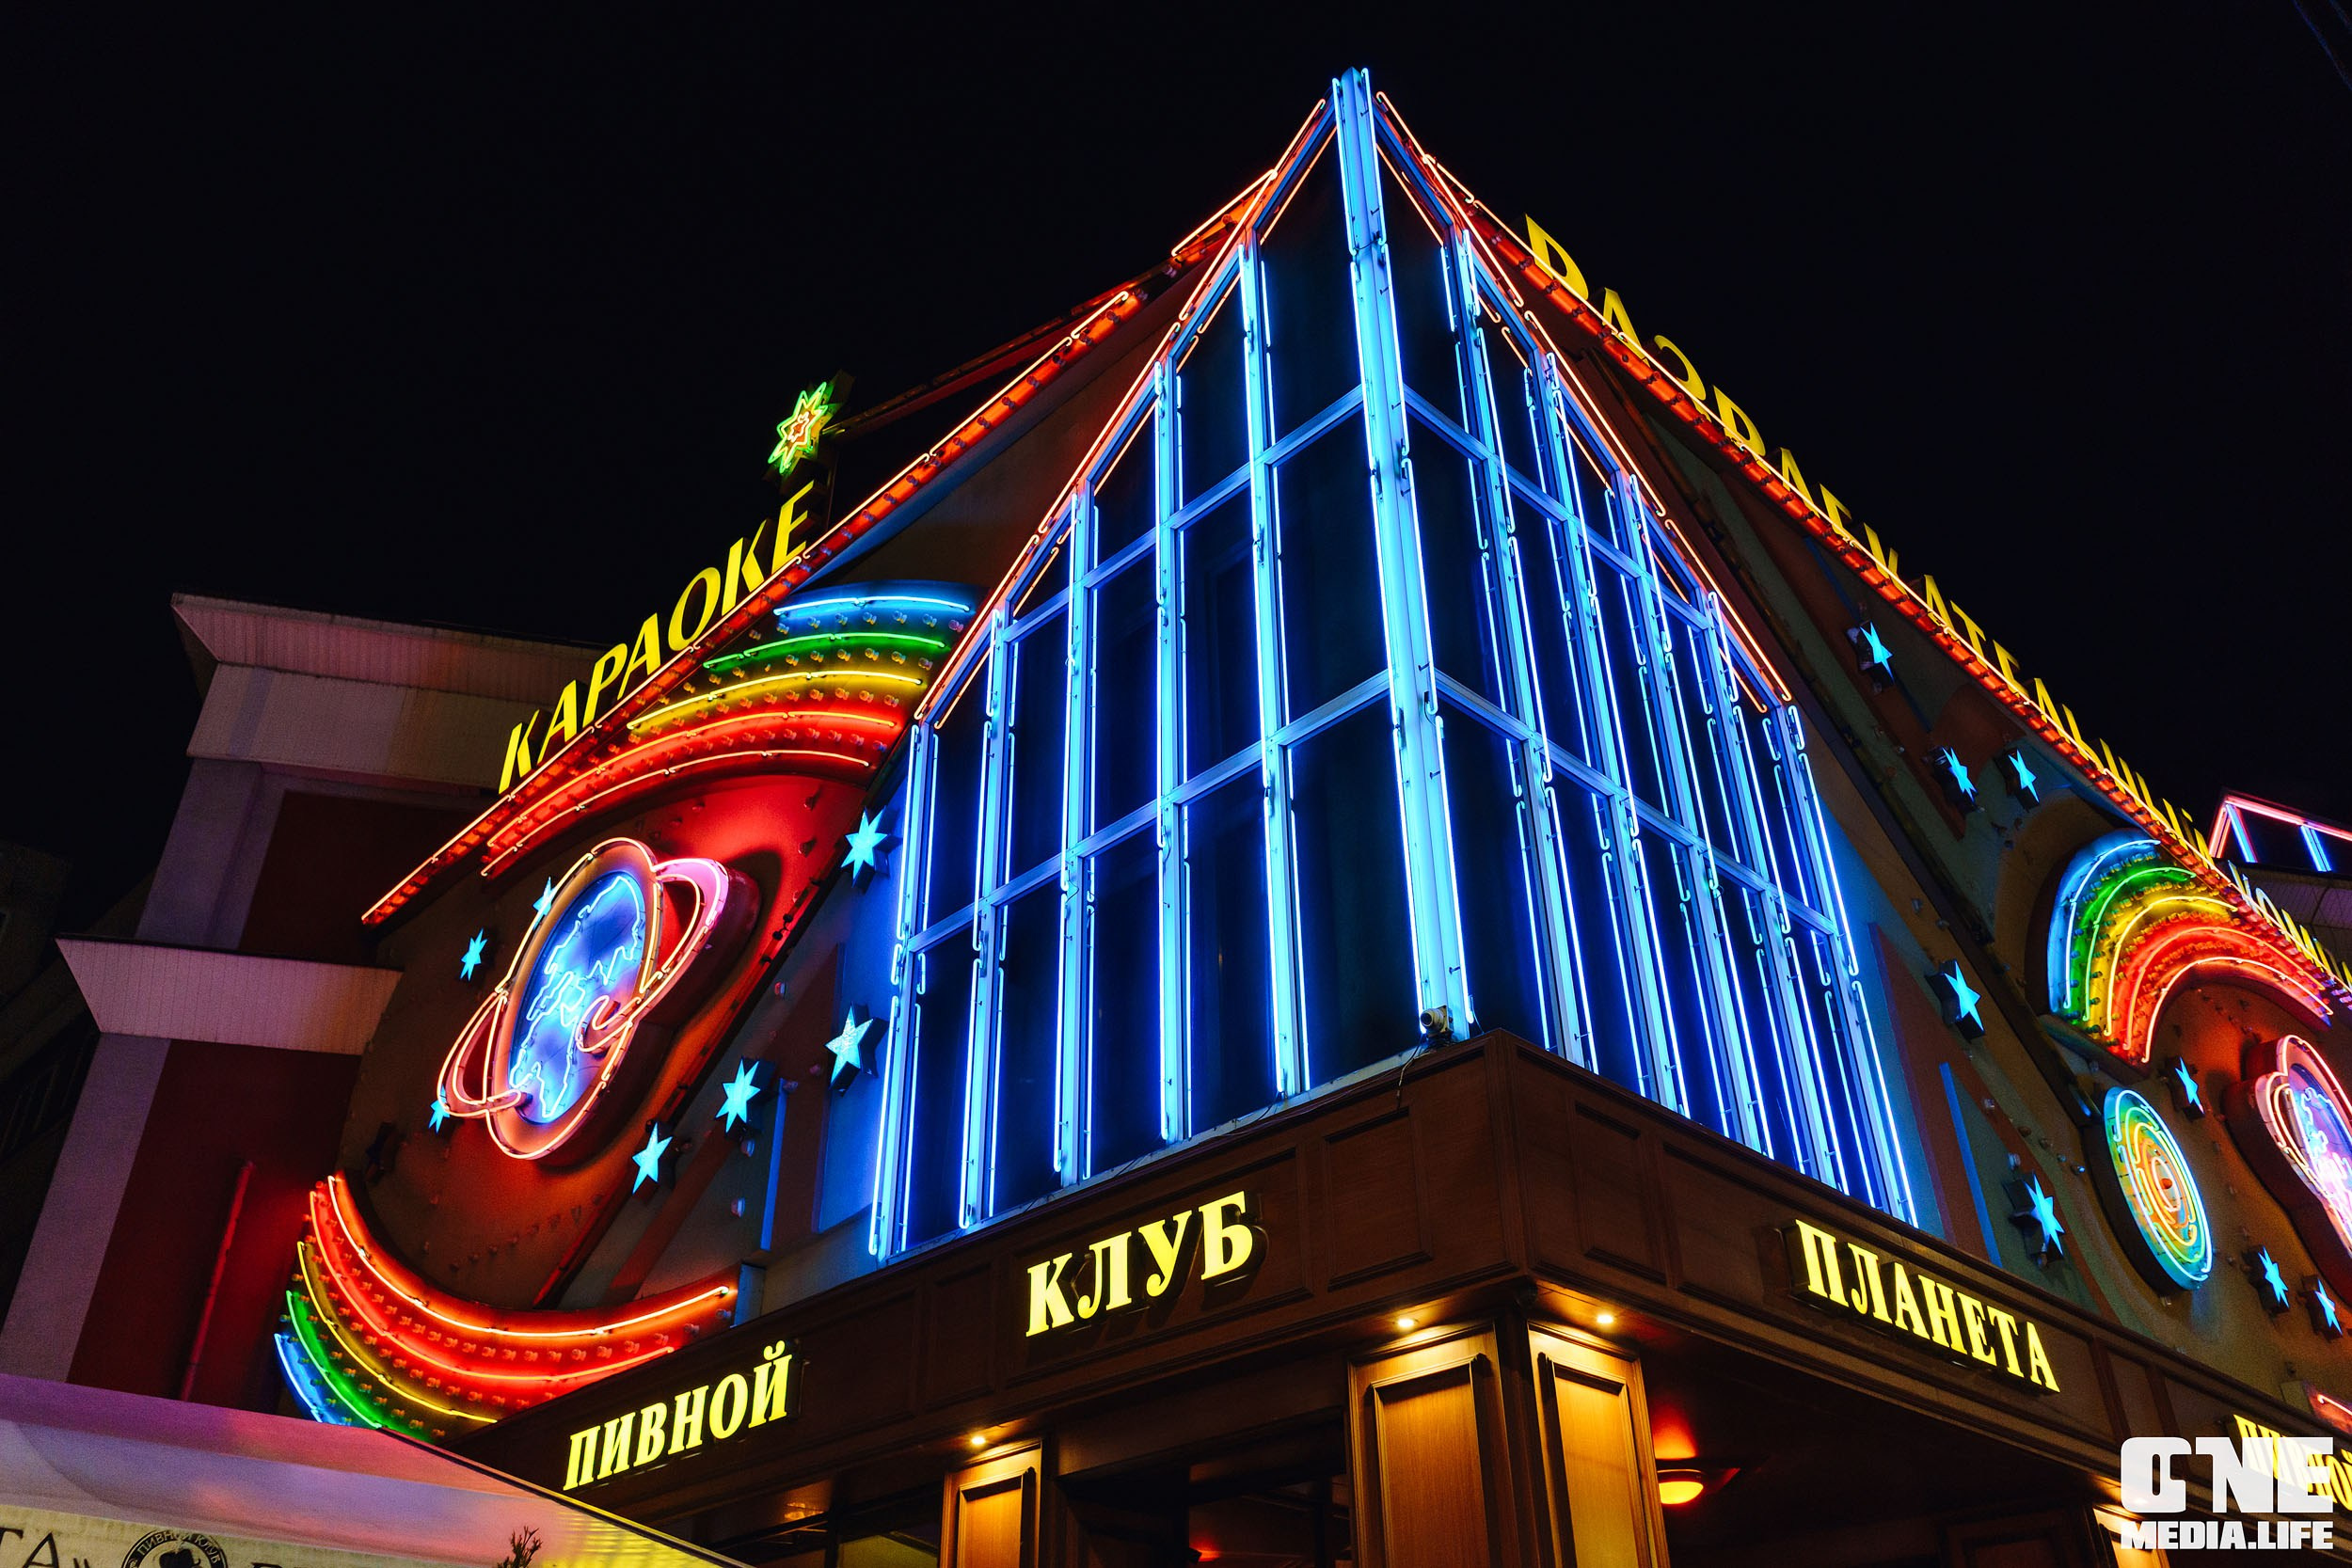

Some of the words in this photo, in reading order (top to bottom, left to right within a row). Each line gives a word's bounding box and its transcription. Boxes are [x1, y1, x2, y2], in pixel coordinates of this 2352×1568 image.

[499, 480, 815, 795] КАРАОКЕ
[564, 1340, 793, 1490] ПИВНОЙ
[1025, 1191, 1254, 1337] КЛУБ
[1795, 1219, 2060, 1392] ПЛАНЕТА
